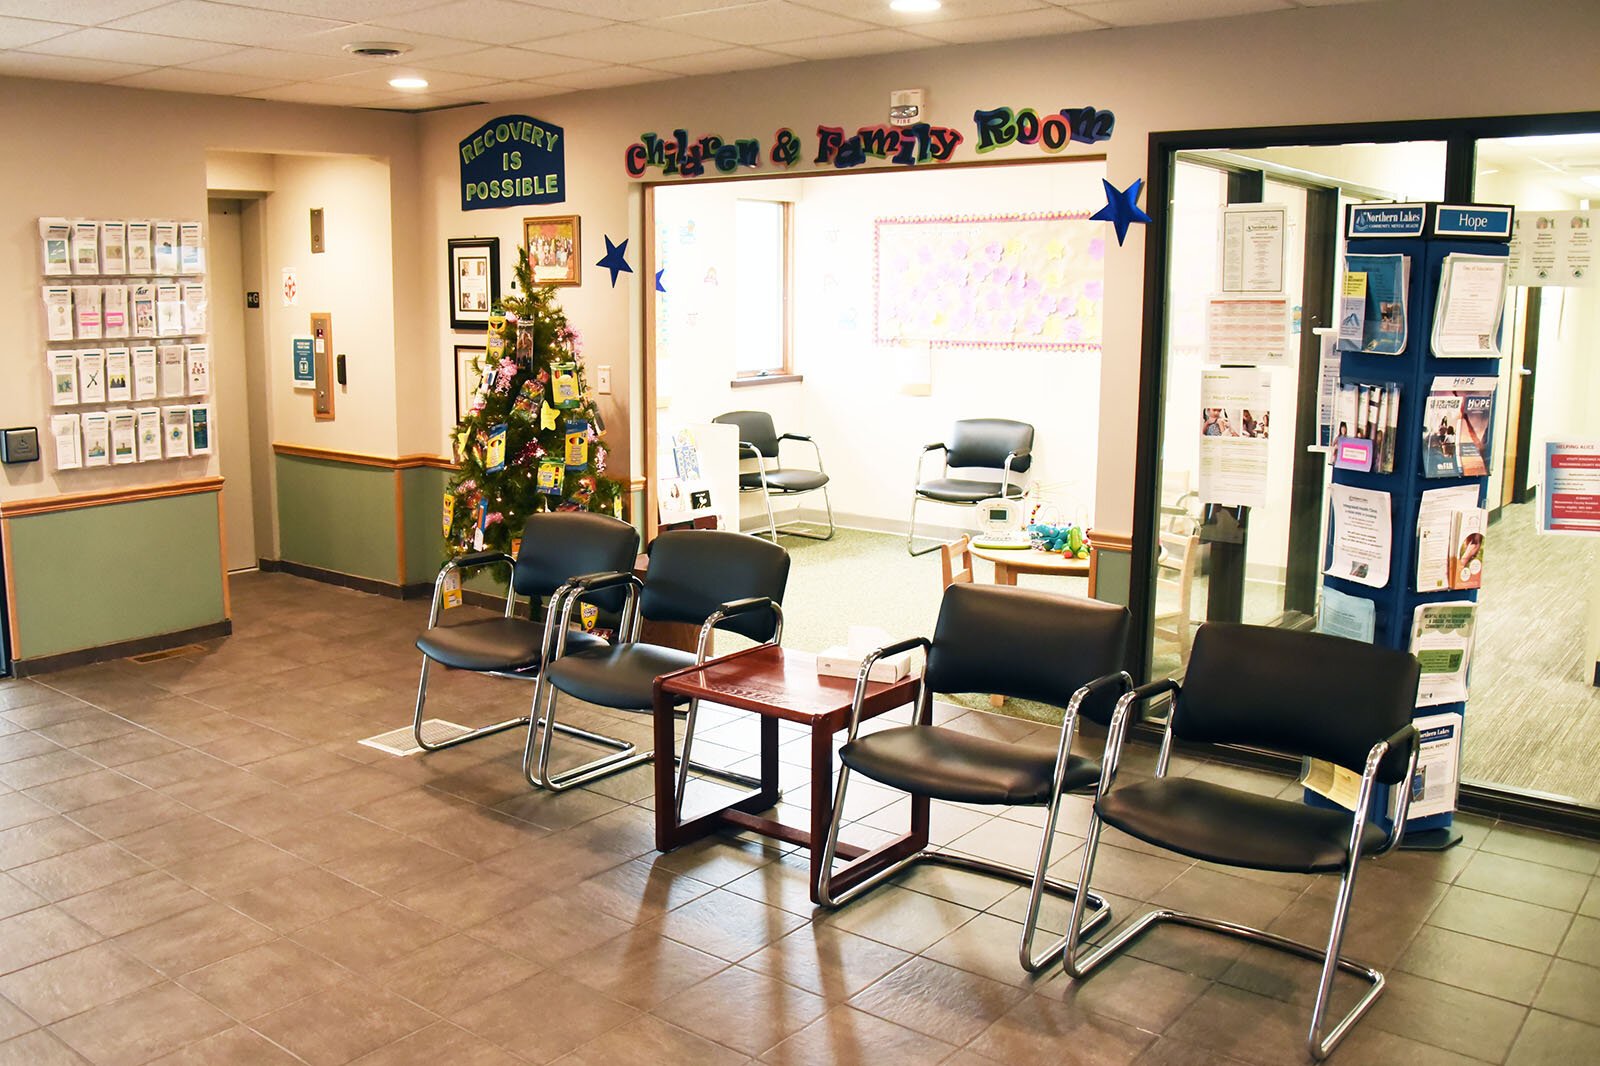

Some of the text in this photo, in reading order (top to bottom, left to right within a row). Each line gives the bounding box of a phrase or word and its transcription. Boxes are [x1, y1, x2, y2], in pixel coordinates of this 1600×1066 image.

[461, 121, 559, 165] RECOVERY
[626, 129, 760, 177] Children
[771, 129, 800, 166] &
[815, 124, 963, 167] Family
[503, 151, 522, 171] IS
[466, 174, 558, 201] POSSIBLE
[1366, 211, 1420, 222] Northern Lakes
[1459, 213, 1488, 230] Hope
